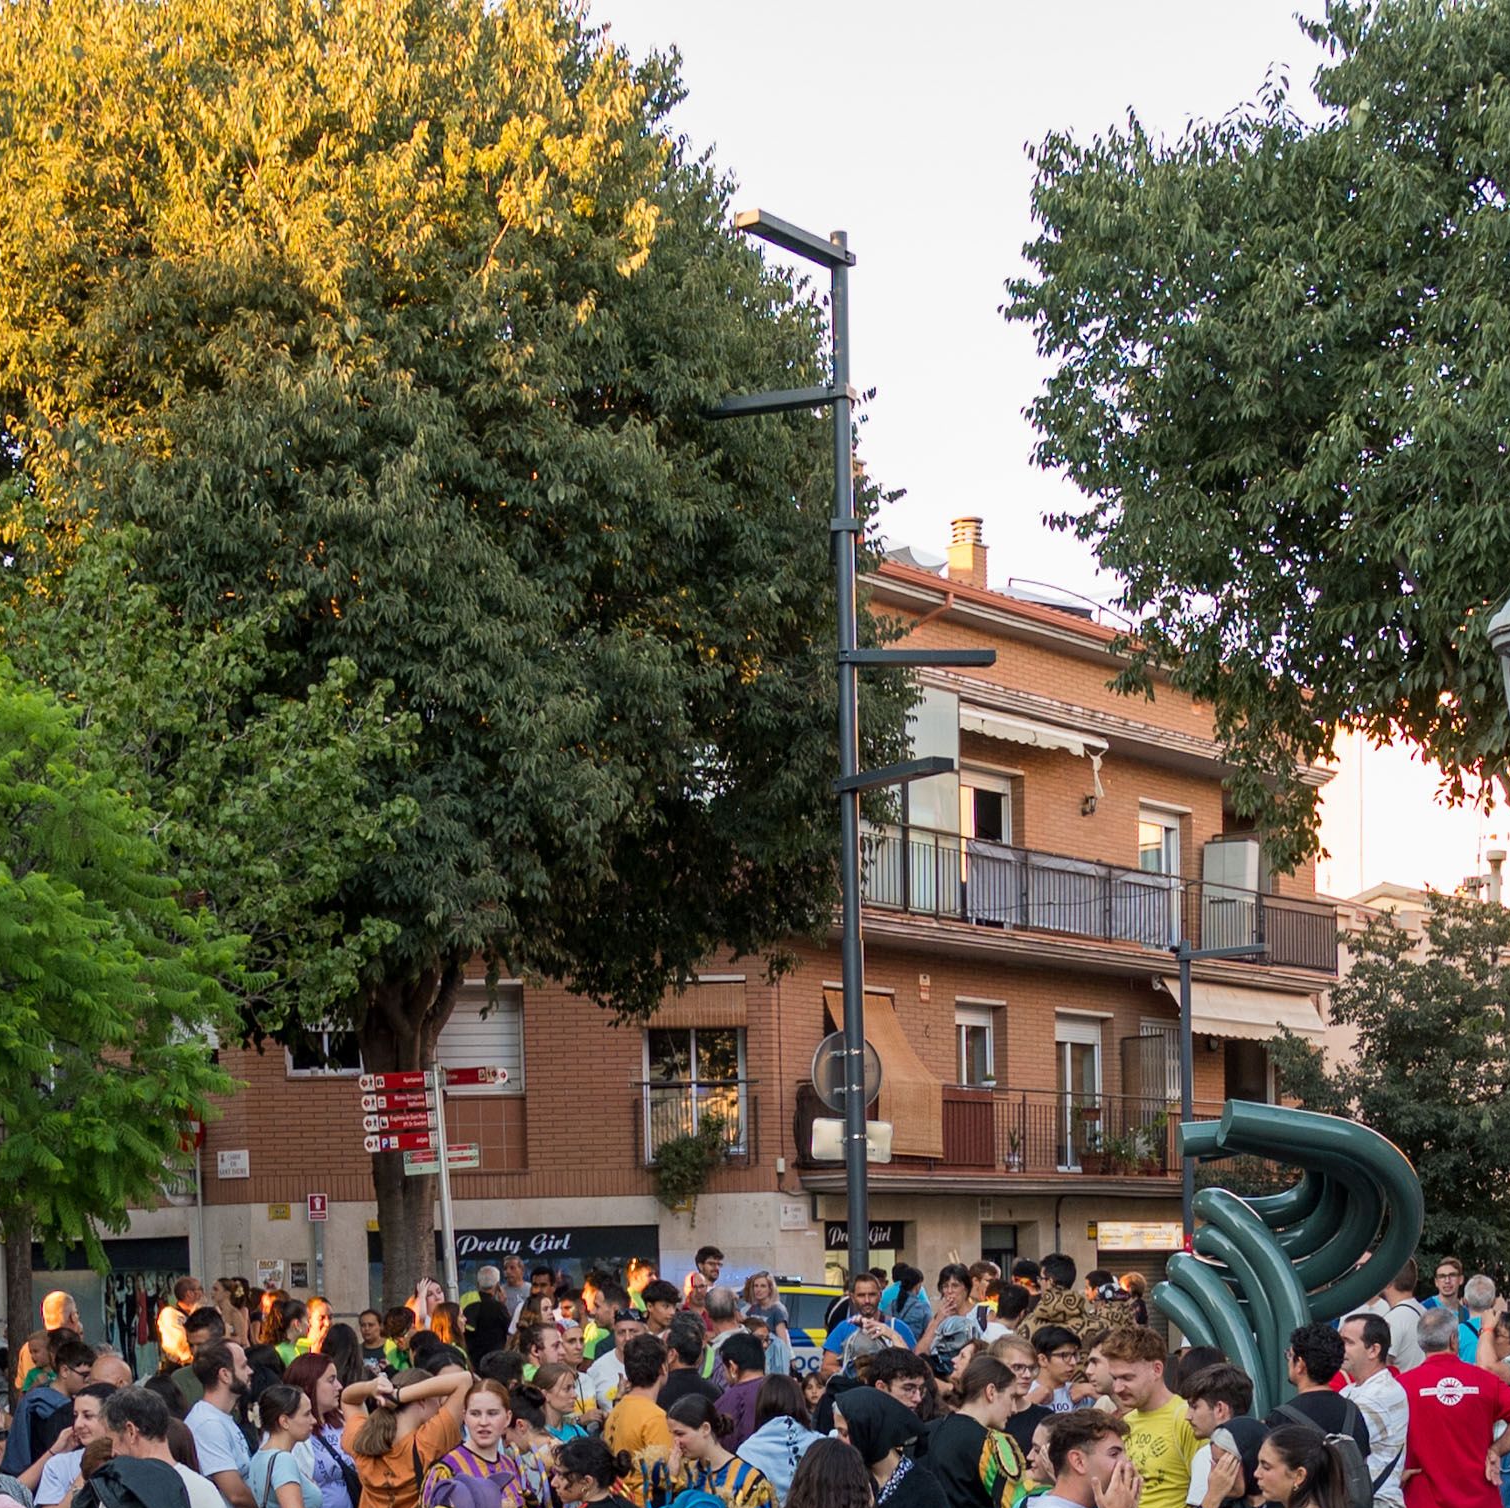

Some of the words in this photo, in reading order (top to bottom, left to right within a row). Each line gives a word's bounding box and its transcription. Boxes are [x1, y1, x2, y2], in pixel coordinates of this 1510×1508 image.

[456, 1234, 522, 1256] Pretty
[527, 1232, 572, 1255] Girl
[869, 1226, 892, 1245] Girl
